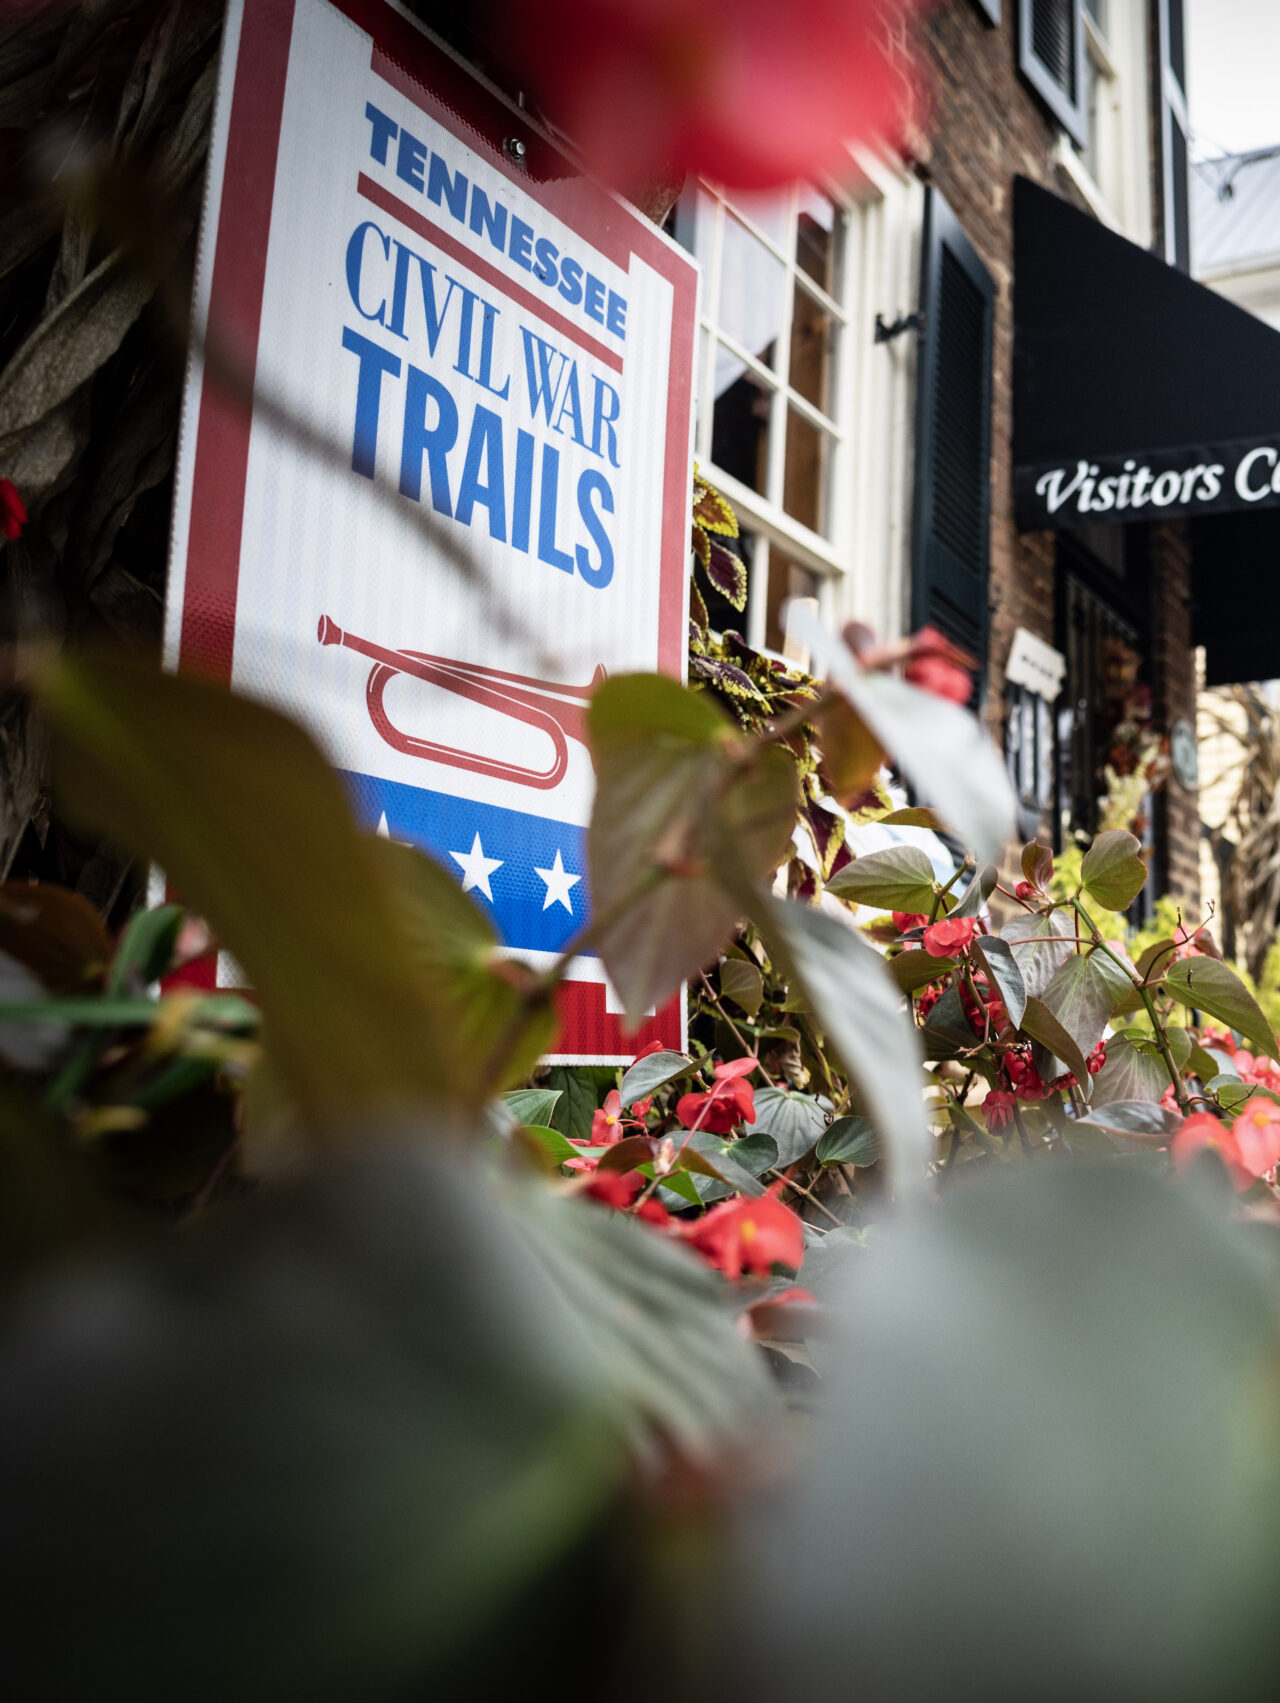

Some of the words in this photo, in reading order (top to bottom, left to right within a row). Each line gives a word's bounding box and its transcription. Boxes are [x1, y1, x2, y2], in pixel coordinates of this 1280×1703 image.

[365, 102, 627, 340] TENNESSEE
[341, 326, 616, 589] TRAILS
[345, 221, 511, 401] CIVIL
[519, 325, 620, 468] WAR
[1035, 460, 1225, 514] Visitors
